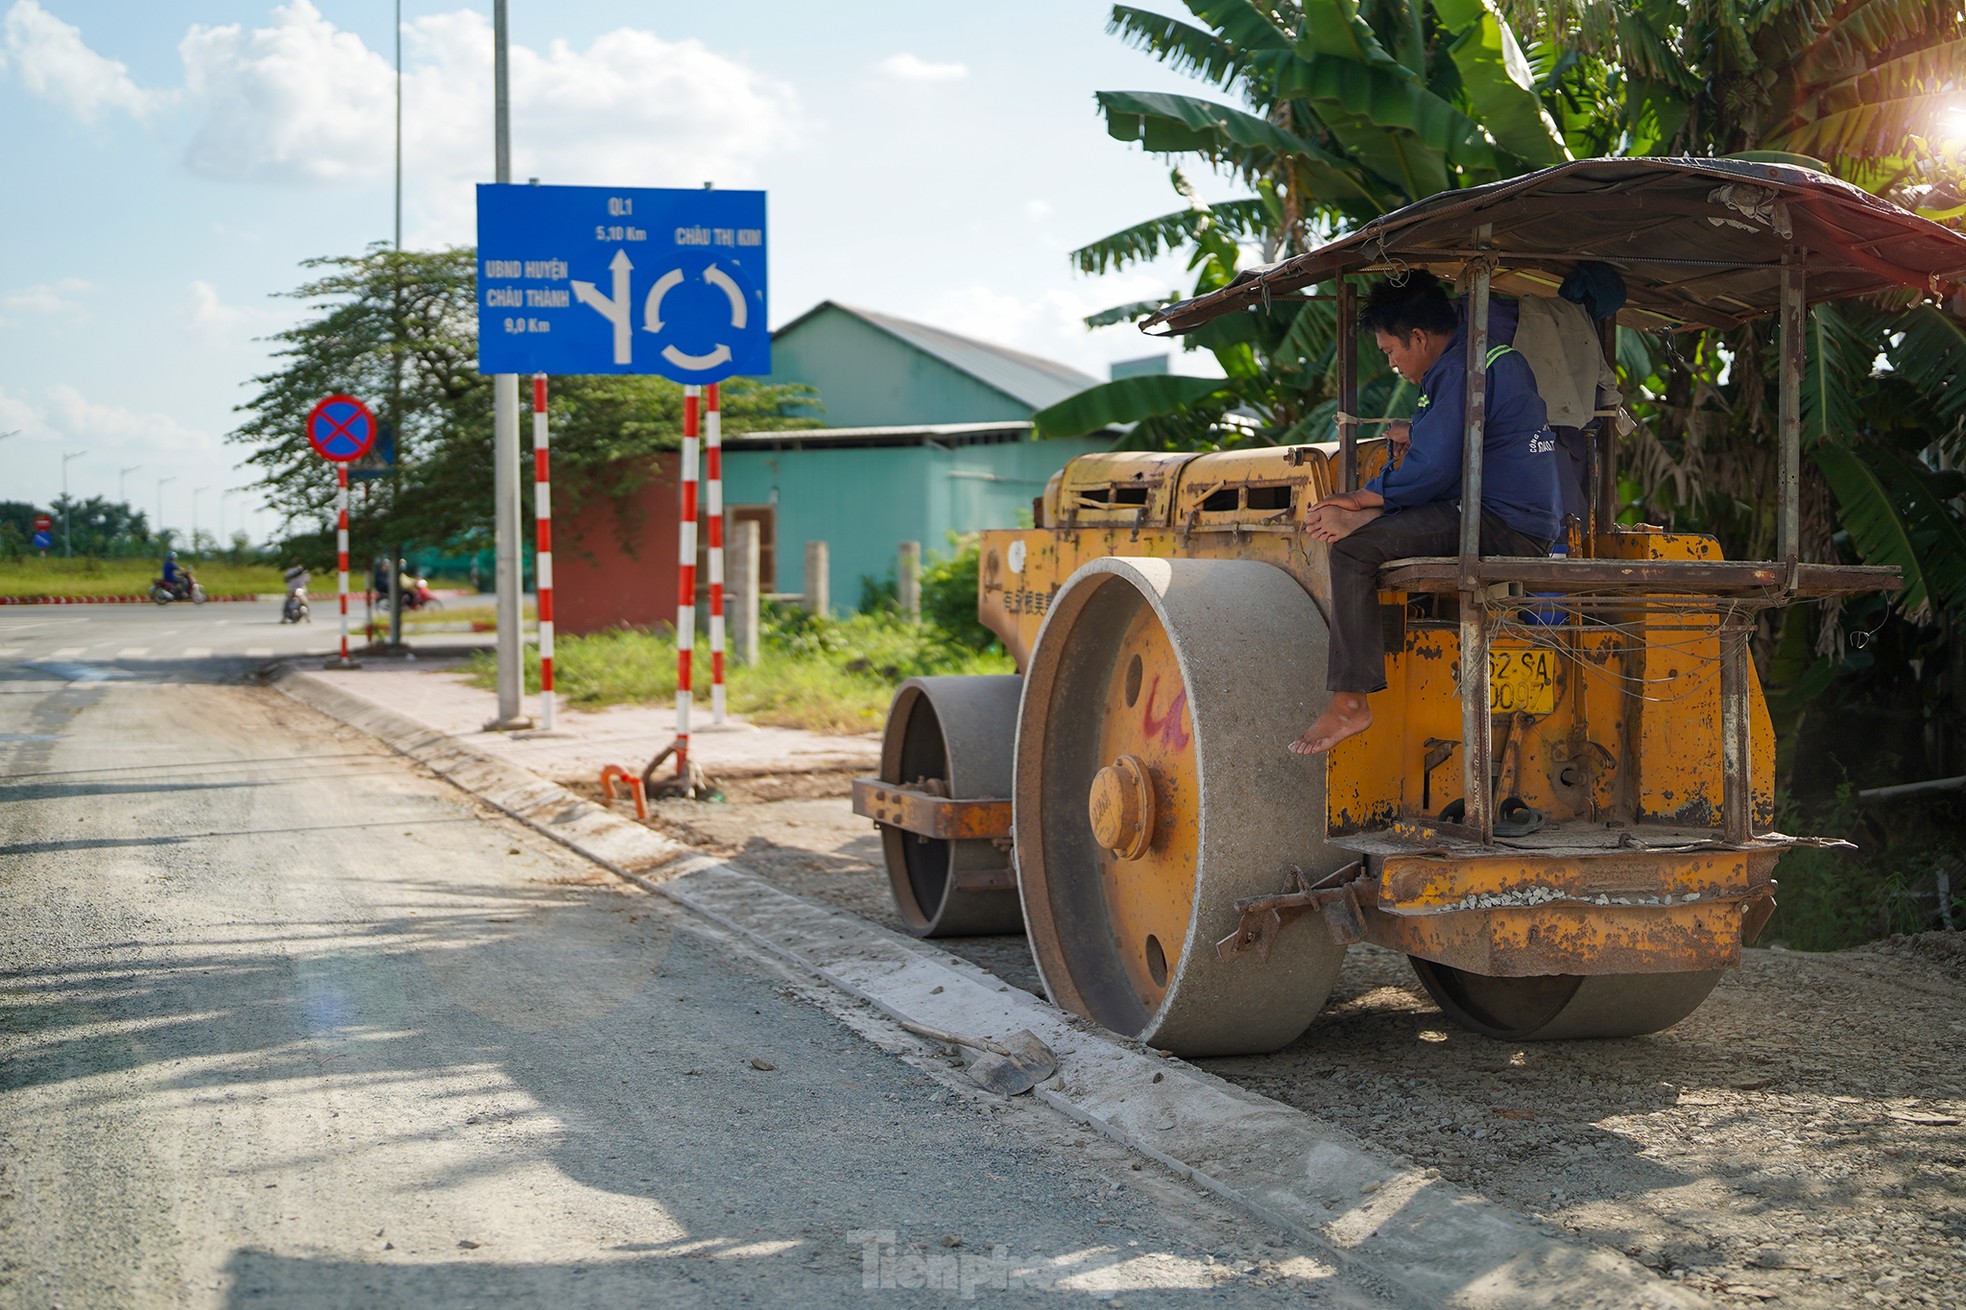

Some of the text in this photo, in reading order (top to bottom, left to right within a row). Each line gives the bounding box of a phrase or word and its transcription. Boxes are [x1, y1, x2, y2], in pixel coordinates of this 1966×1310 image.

[608, 197, 633, 216] QL1
[596, 225, 647, 242] 5,10 Km
[675, 224, 762, 248] CHÂU THỊ KIM
[485, 257, 569, 281] UBND HUYỆN
[486, 285, 570, 308] CHÂU THÀNH
[504, 317, 551, 334] 9,0 Km
